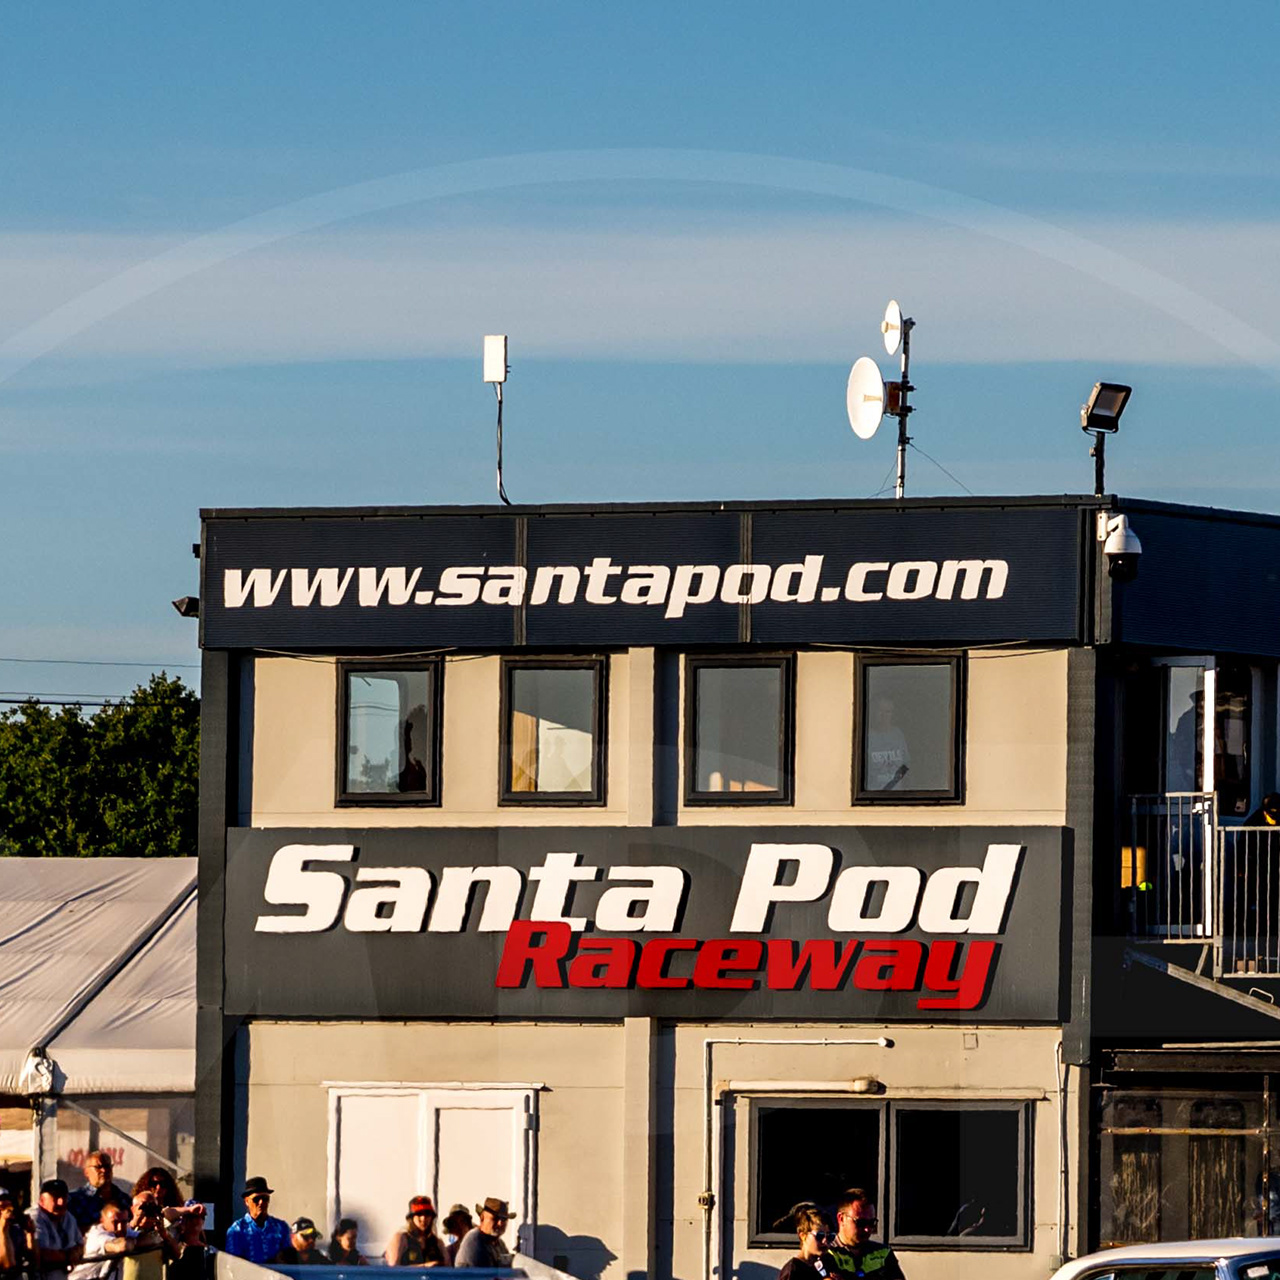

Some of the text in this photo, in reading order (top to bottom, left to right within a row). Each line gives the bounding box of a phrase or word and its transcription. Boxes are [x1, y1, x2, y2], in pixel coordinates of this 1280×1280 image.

[222, 554, 1009, 619] www.santapod.com
[254, 842, 1024, 935] Santa Pod
[495, 919, 998, 1011] Raceway
